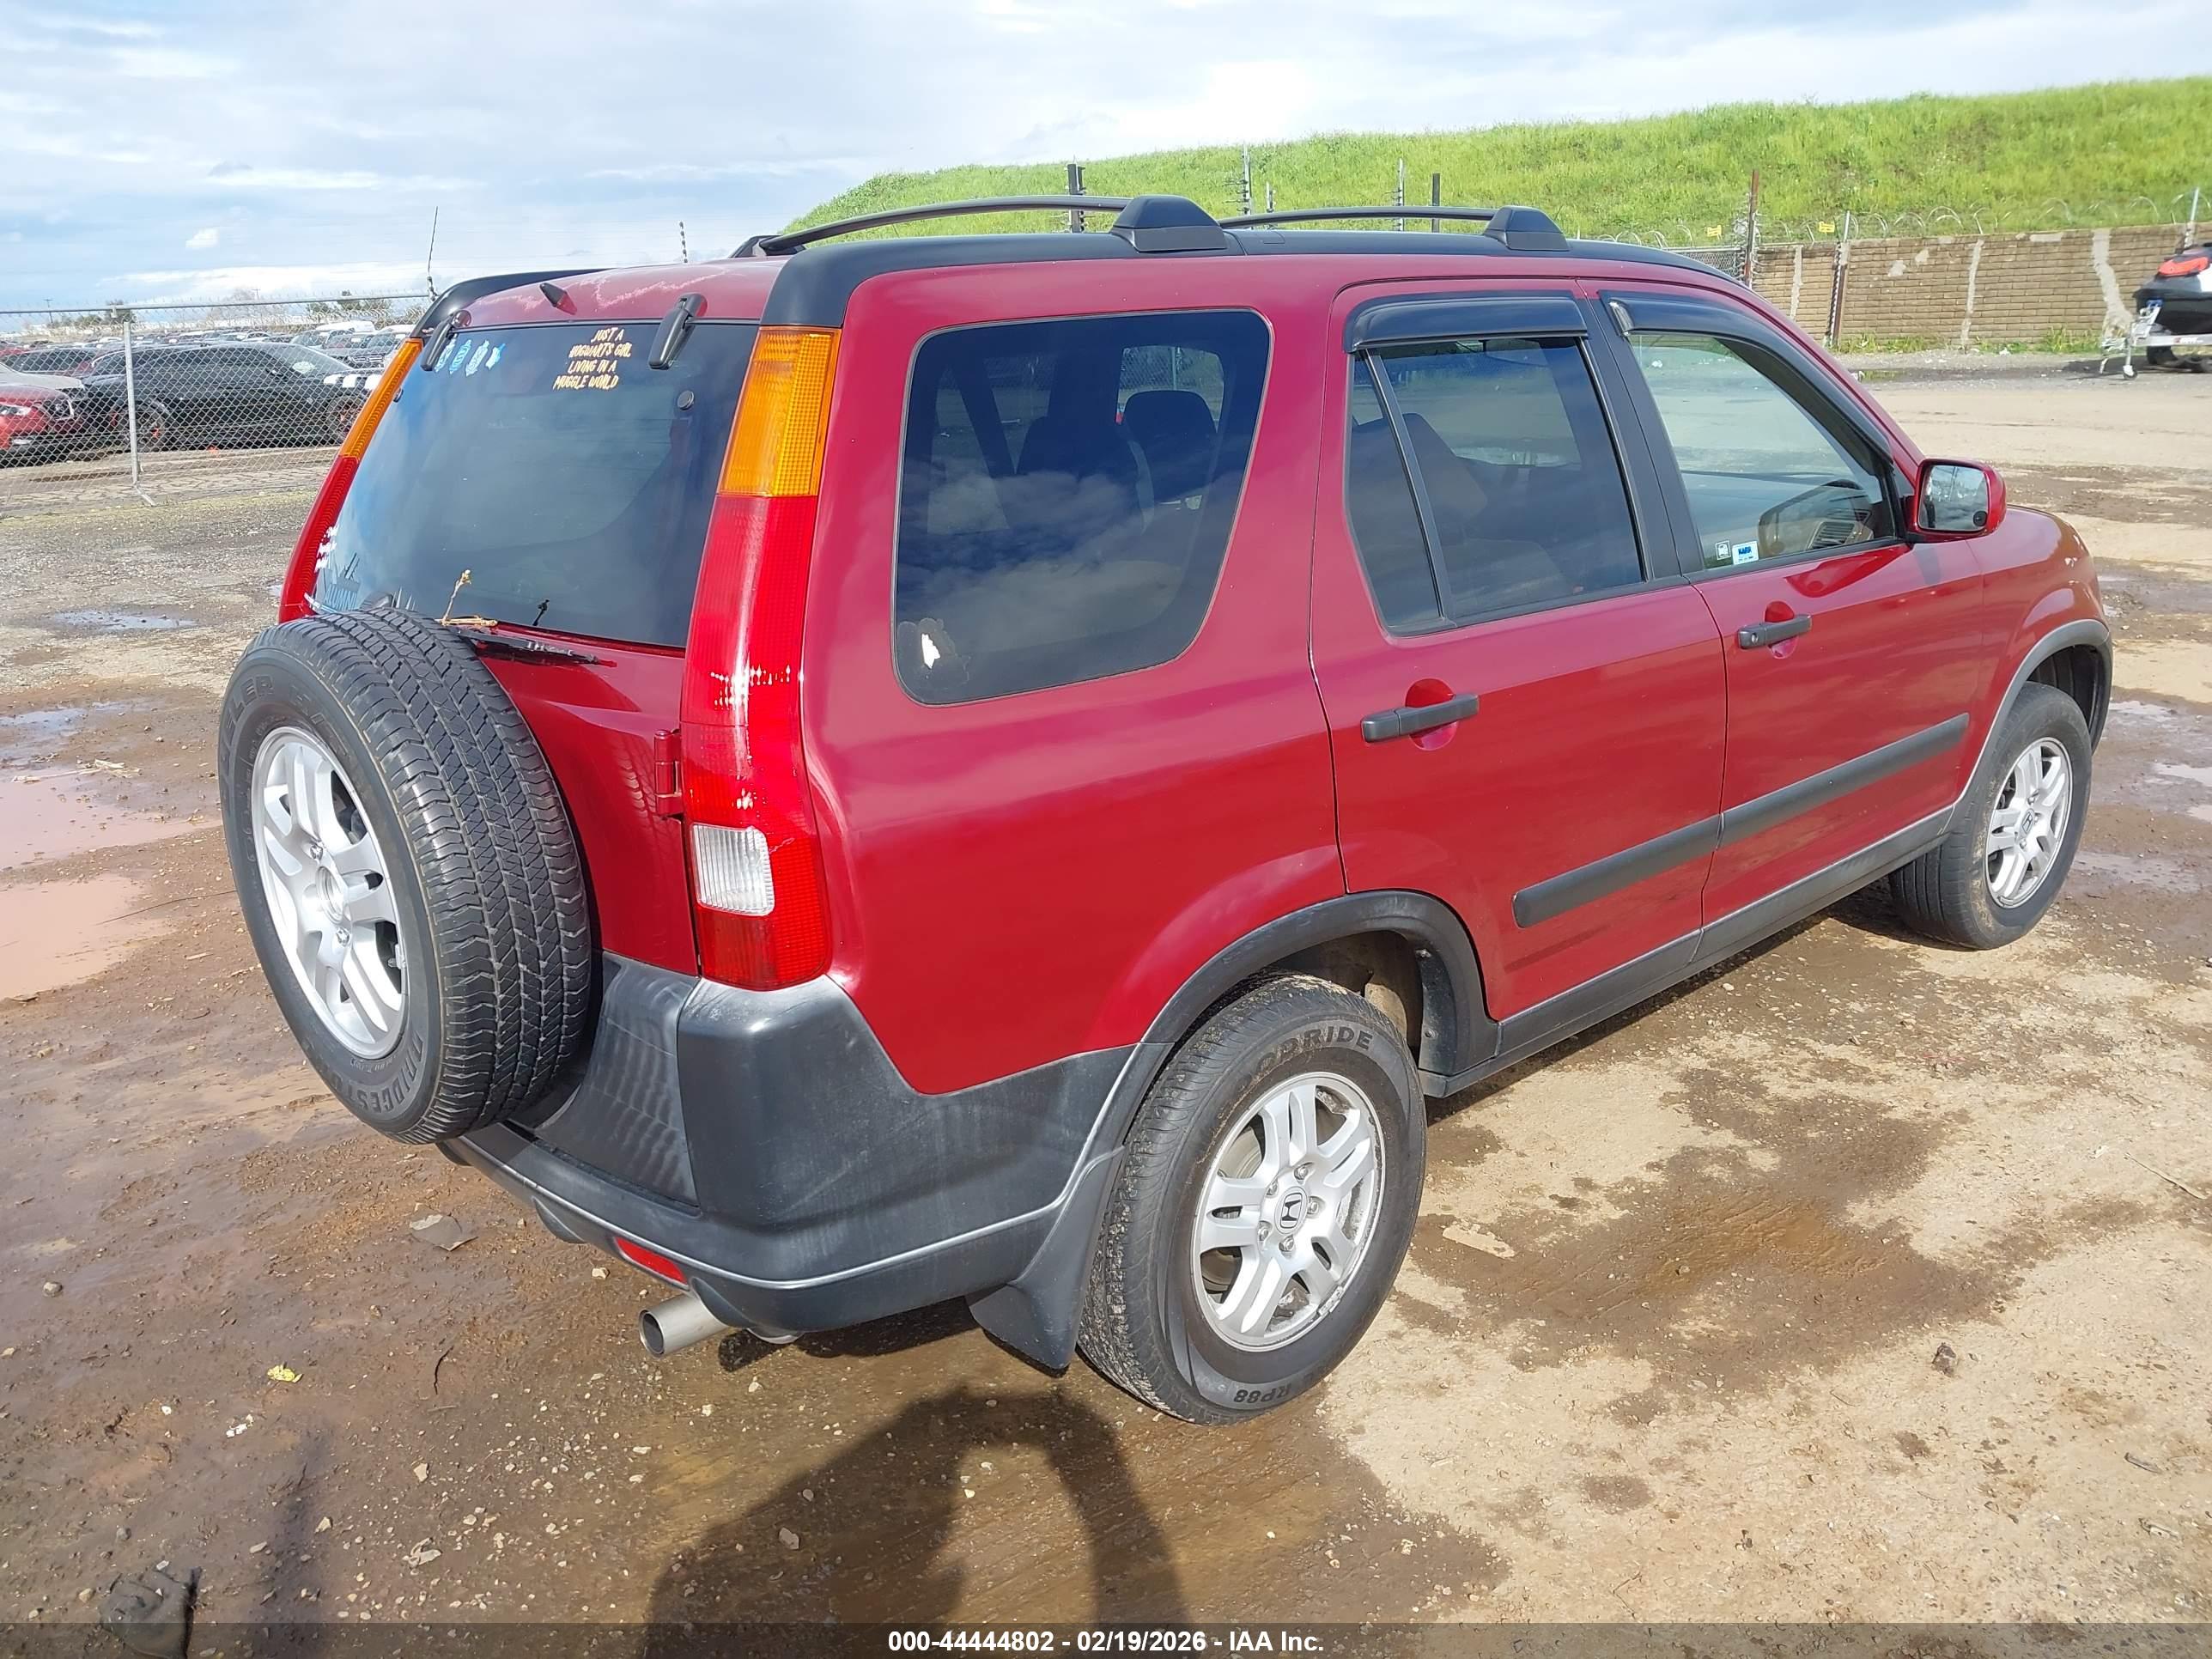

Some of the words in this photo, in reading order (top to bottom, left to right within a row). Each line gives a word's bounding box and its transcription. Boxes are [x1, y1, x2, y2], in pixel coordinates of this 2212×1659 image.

[590, 327, 618, 343] JUST
[614, 329, 625, 341] A
[568, 343, 615, 358] HOGWARTS
[614, 342, 633, 357] GIRL
[568, 359, 597, 374] LIVING
[597, 359, 610, 373] IN
[607, 360, 617, 372] A
[552, 374, 590, 390] MUGGLE
[588, 374, 619, 389] WORLD
[1233, 1383, 1291, 1403] RP88
